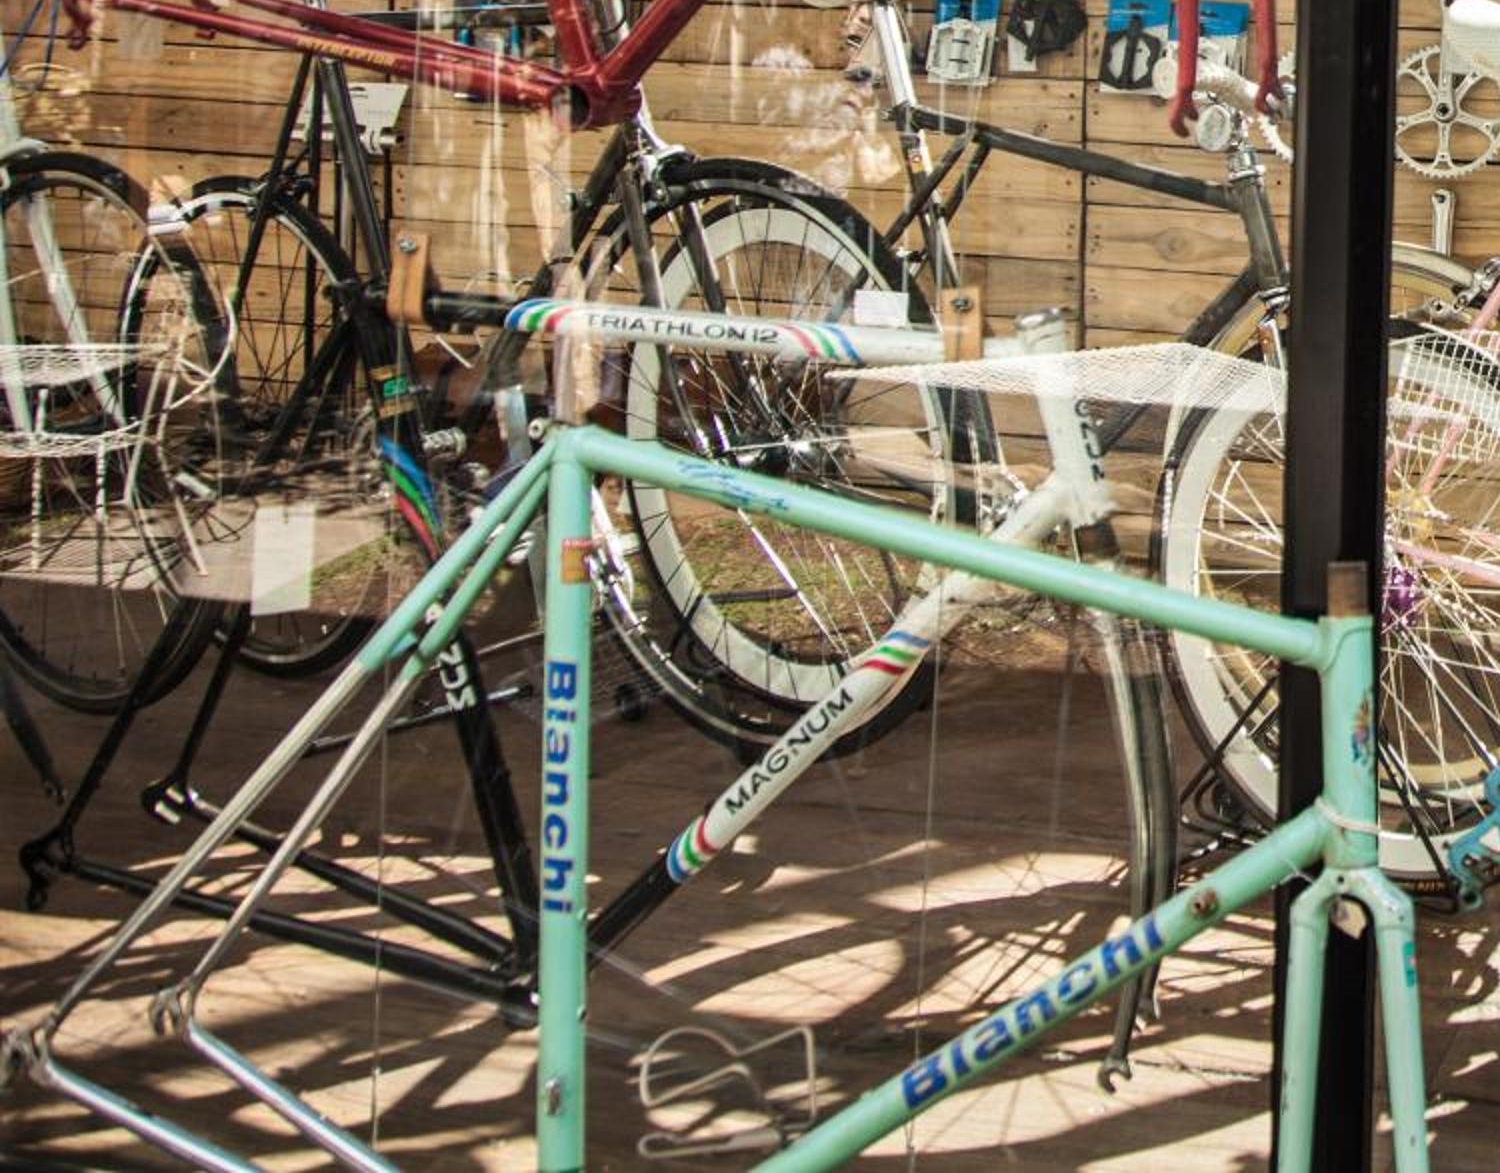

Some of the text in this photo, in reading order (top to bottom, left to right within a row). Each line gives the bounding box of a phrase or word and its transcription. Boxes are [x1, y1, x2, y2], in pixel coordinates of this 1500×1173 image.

[543, 660, 577, 914] Bianchi
[724, 687, 854, 816] MAGNUM
[901, 912, 1165, 1110] Bianchi
